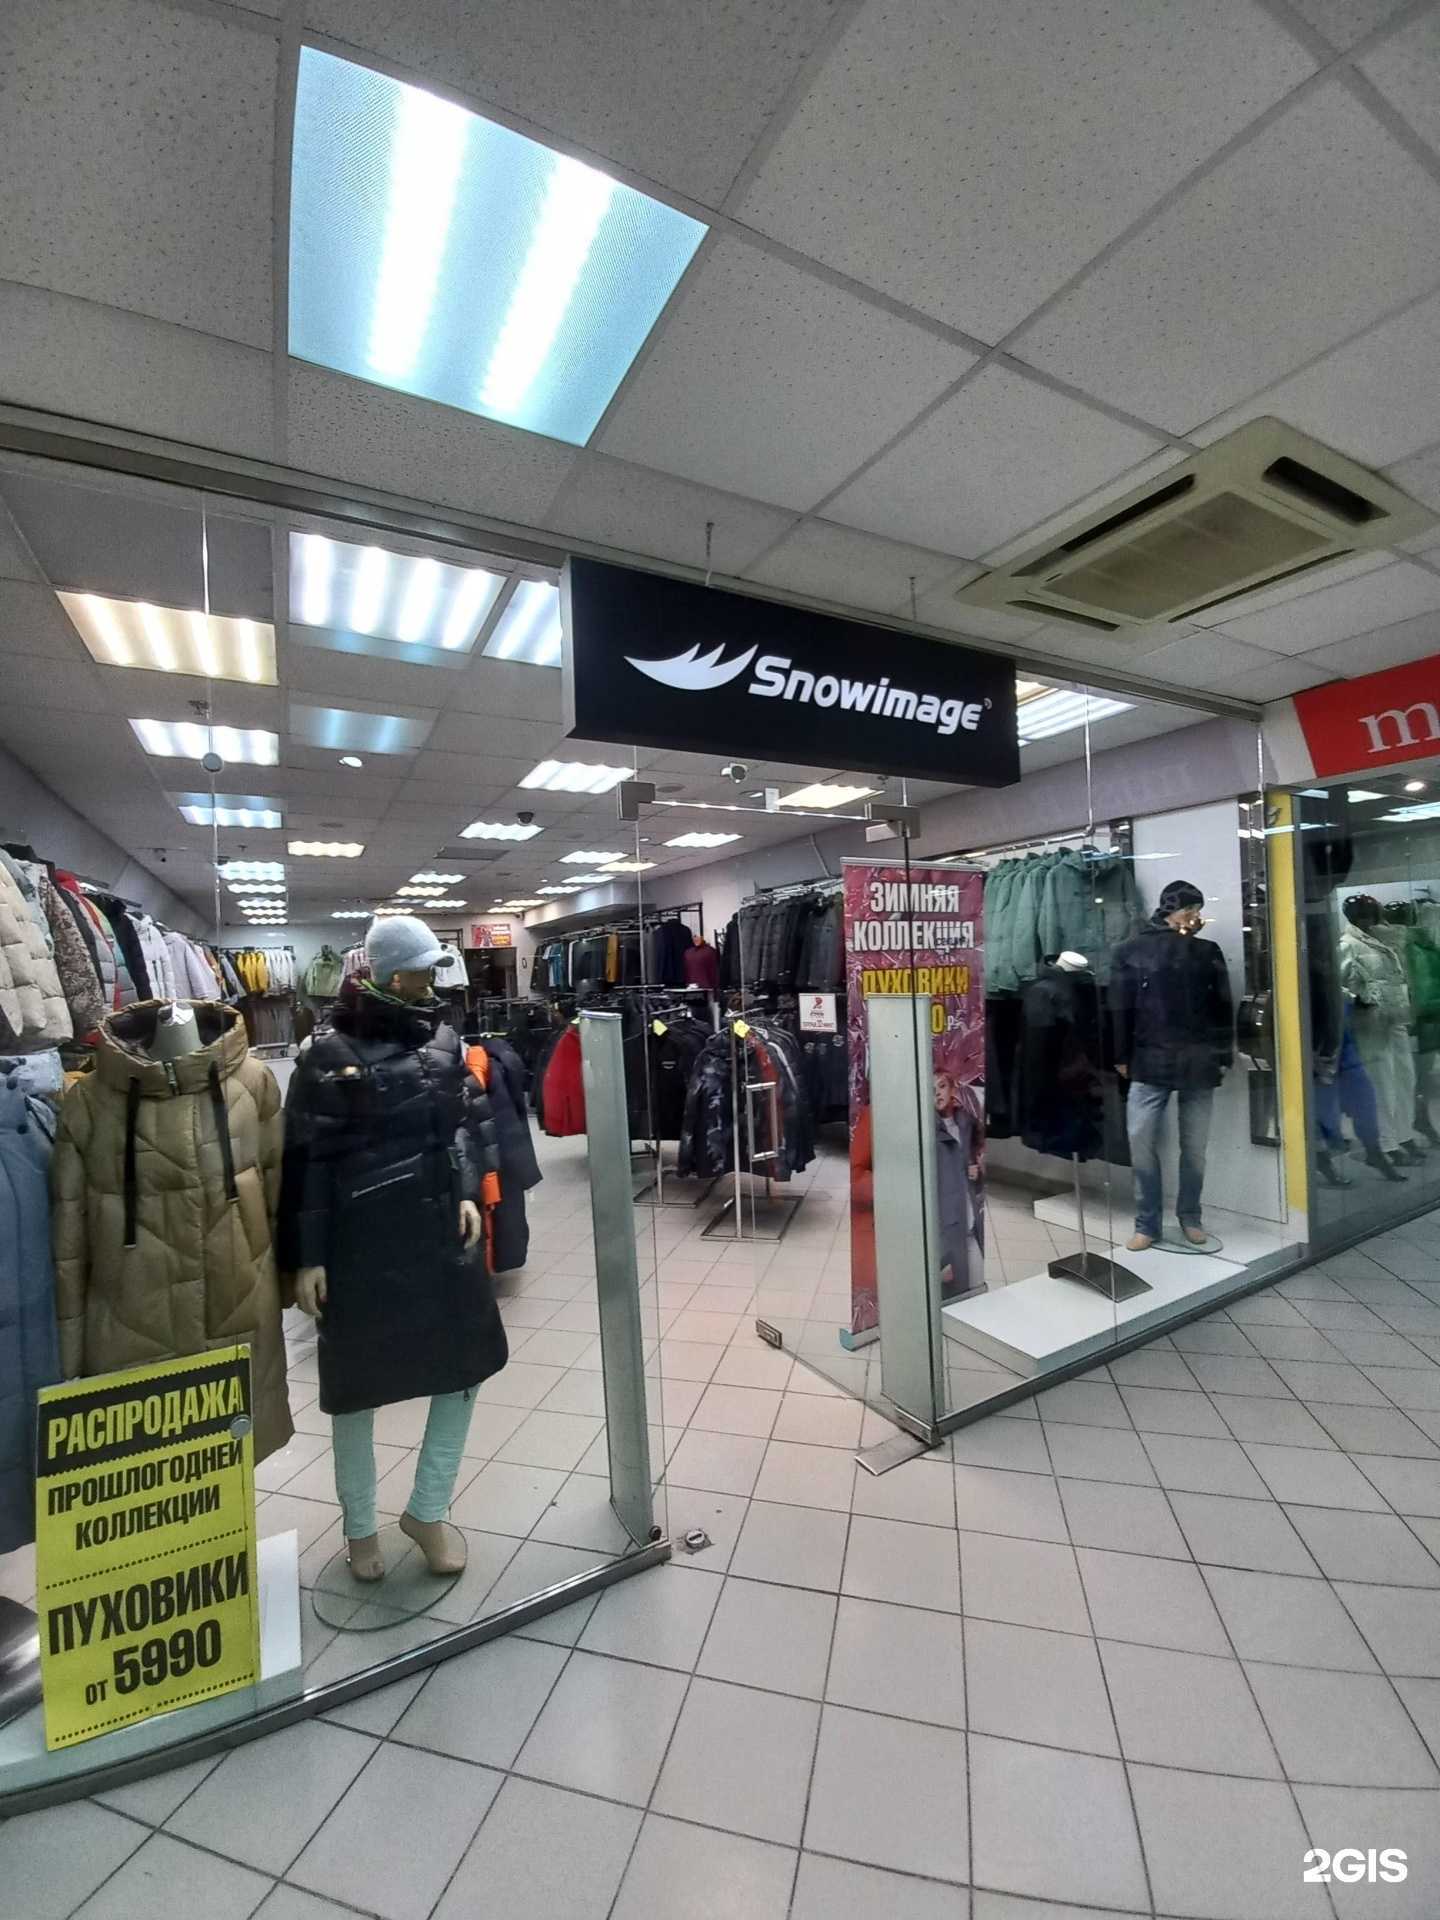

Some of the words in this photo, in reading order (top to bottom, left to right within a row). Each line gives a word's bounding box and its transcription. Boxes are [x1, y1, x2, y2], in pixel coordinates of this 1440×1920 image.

[748, 655, 984, 735] Snowimage
[870, 882, 960, 913] ЗИМНЯЯ
[853, 920, 974, 954] КОЛЛЕКЦИЯ
[48, 1376, 245, 1459] РАСПРОДАЖА
[48, 1438, 243, 1516] ПРОШЛОГОДНЕЙ
[75, 1484, 220, 1550] КОЛЛЕКЦИИ
[47, 1551, 249, 1656] ПУХОВИКИ
[113, 1619, 222, 1695] 5990
